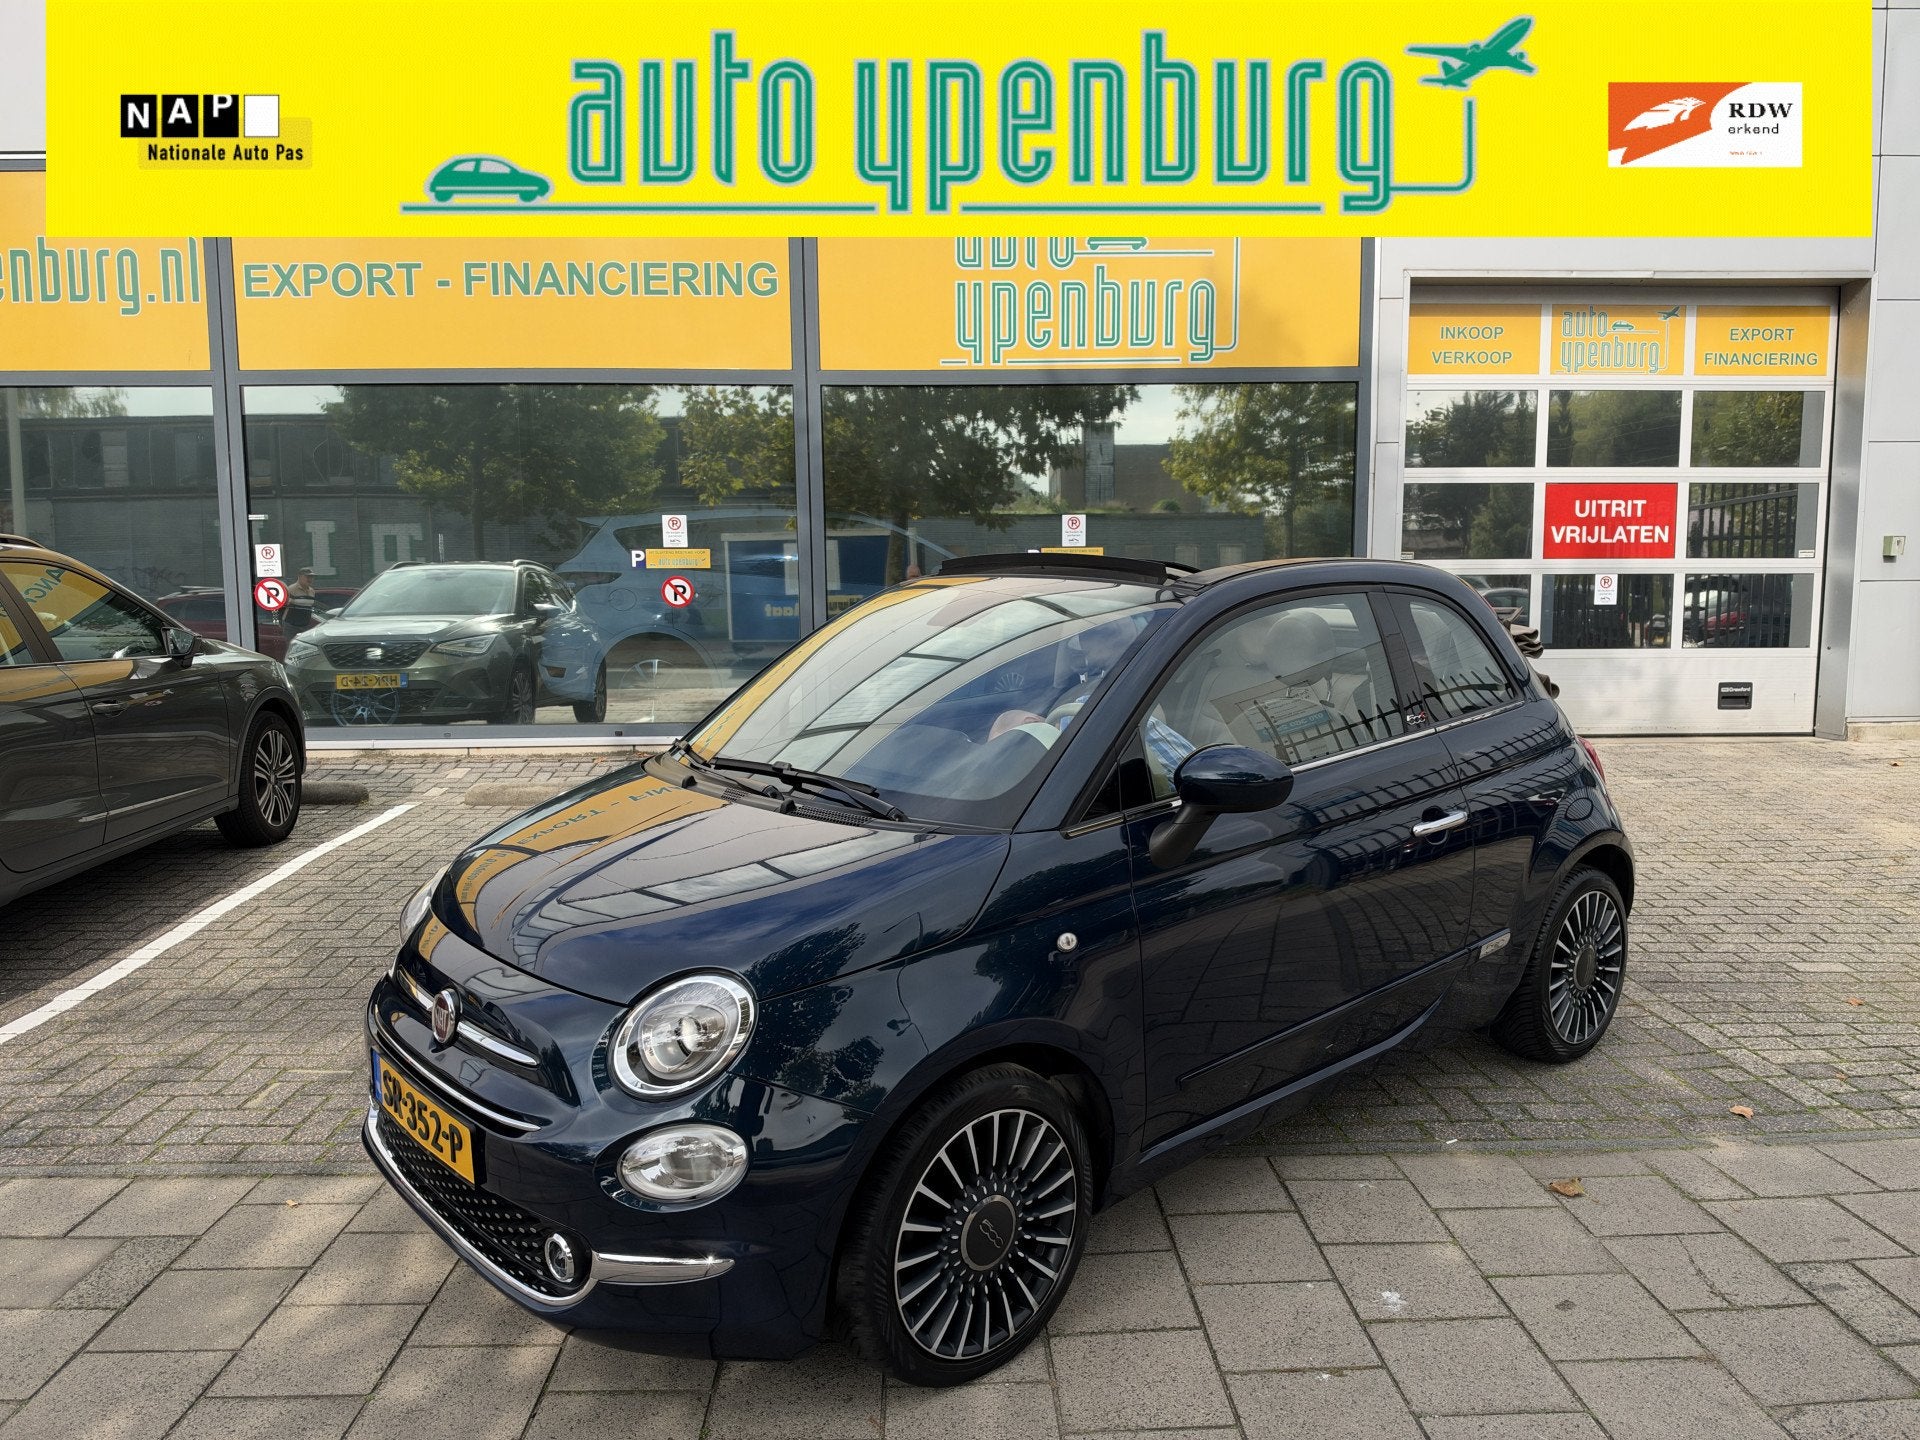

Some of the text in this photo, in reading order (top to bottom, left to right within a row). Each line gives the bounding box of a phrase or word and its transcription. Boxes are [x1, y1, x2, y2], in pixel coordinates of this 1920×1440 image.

[0, 236, 200, 316] nburg.nl
[243, 262, 423, 298] EXPORT
[463, 261, 779, 298] FINANCIERING
[955, 264, 1216, 364] ypenburg
[1562, 305, 1608, 338] auto
[1440, 326, 1504, 340] INKOOP
[1729, 328, 1795, 341] EXPORT
[1432, 351, 1512, 364] VERKOOP
[1561, 336, 1660, 373] ypenburg
[1704, 352, 1818, 366] FINANCIERING
[1574, 499, 1647, 518] UITRIT
[1551, 525, 1669, 543] VRIJLATEN
